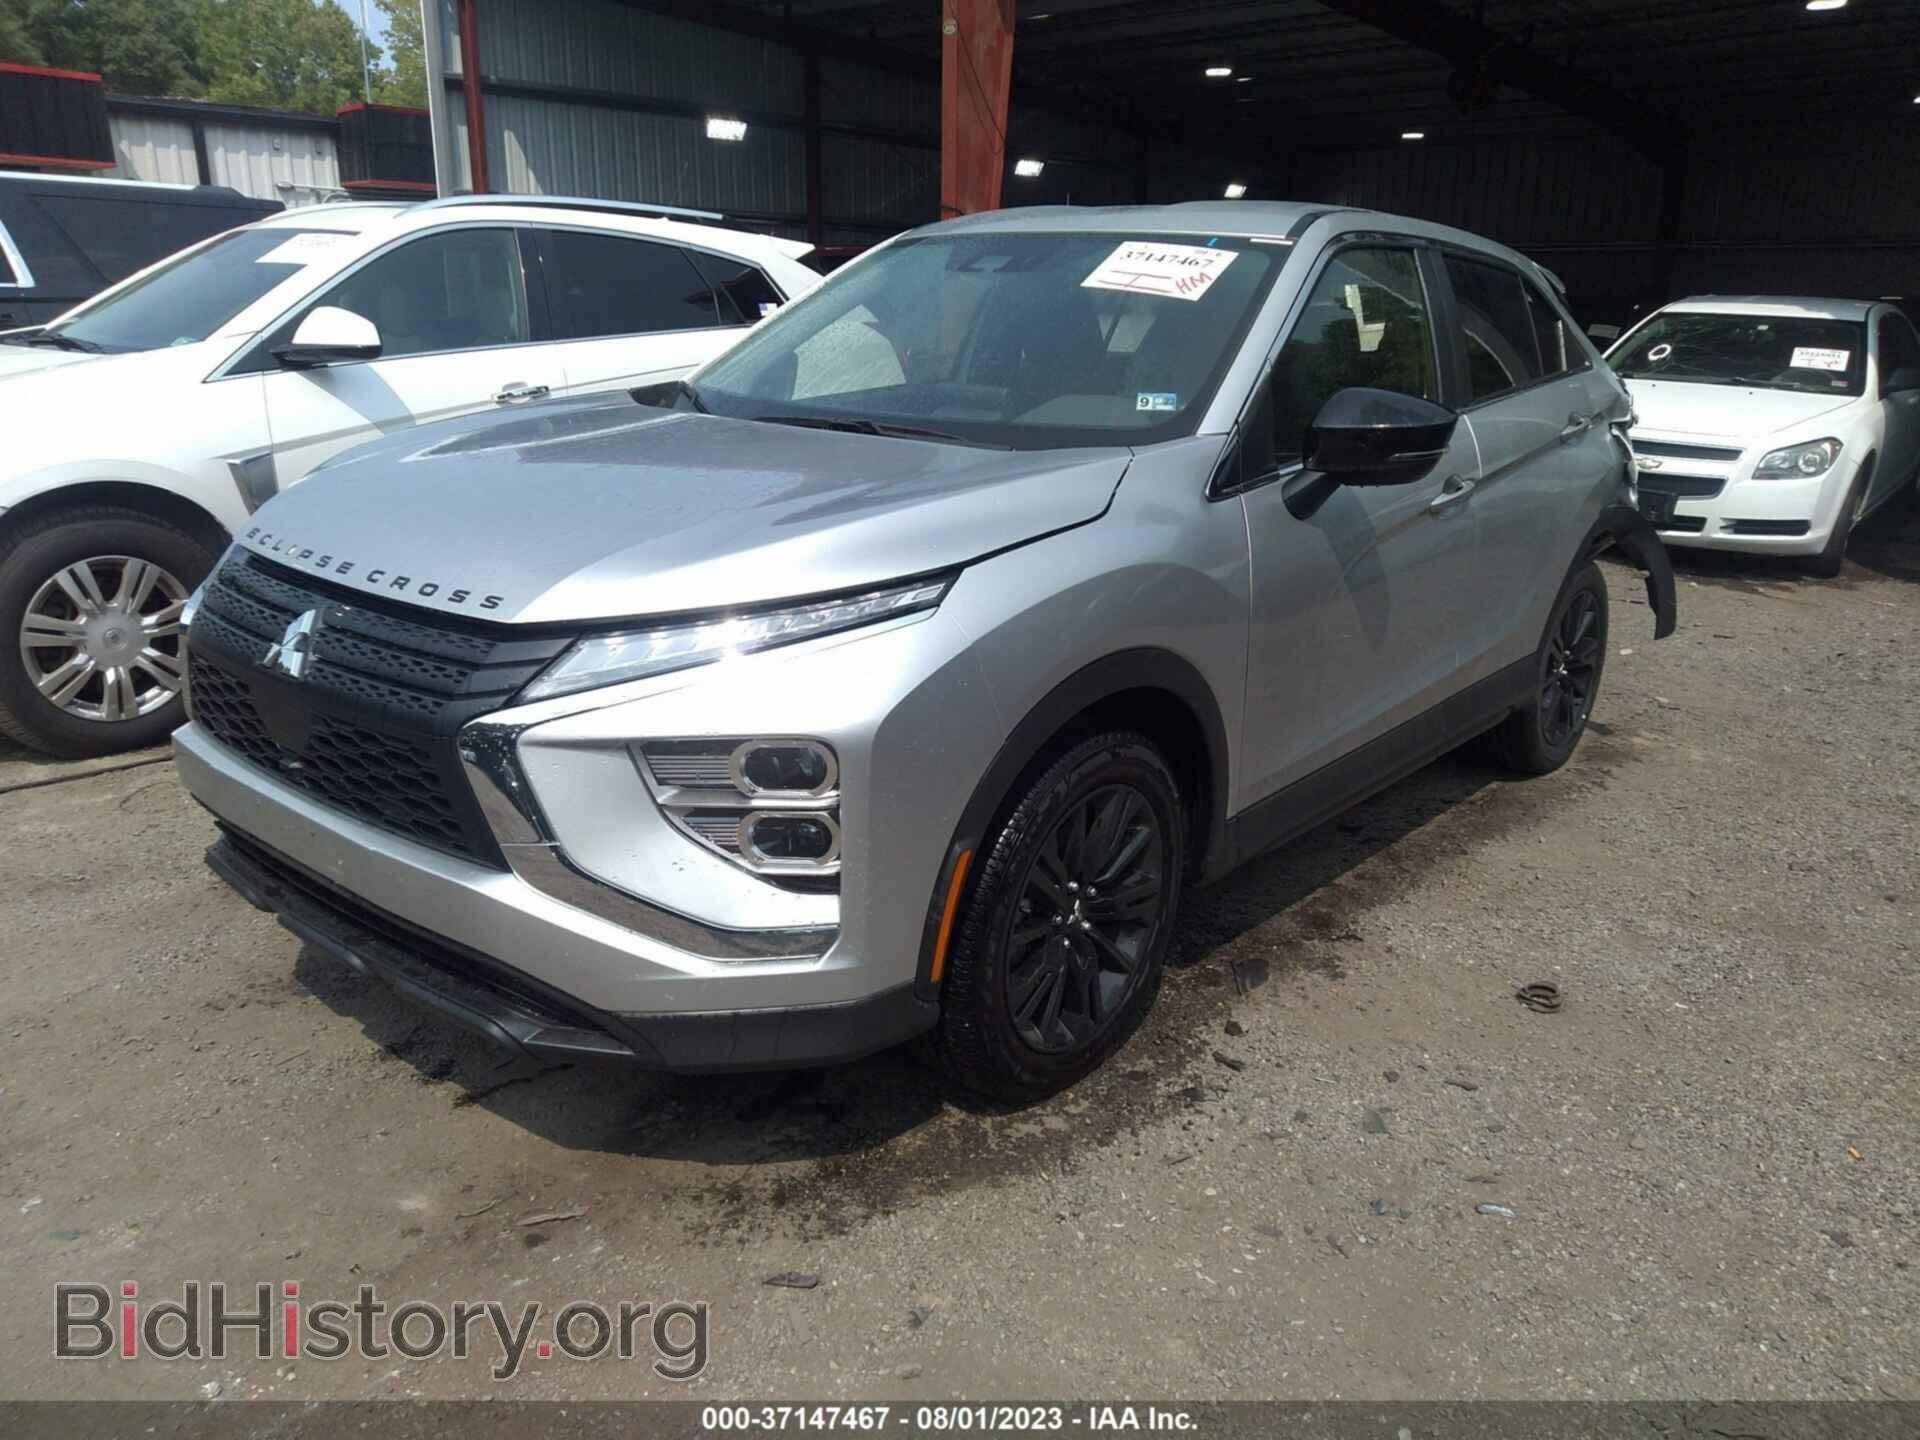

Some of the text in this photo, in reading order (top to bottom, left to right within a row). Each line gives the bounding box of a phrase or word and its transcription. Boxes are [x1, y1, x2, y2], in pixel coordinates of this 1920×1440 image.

[1140, 396, 1150, 408] 9
[246, 527, 505, 610] ECLIPSE CROSS
